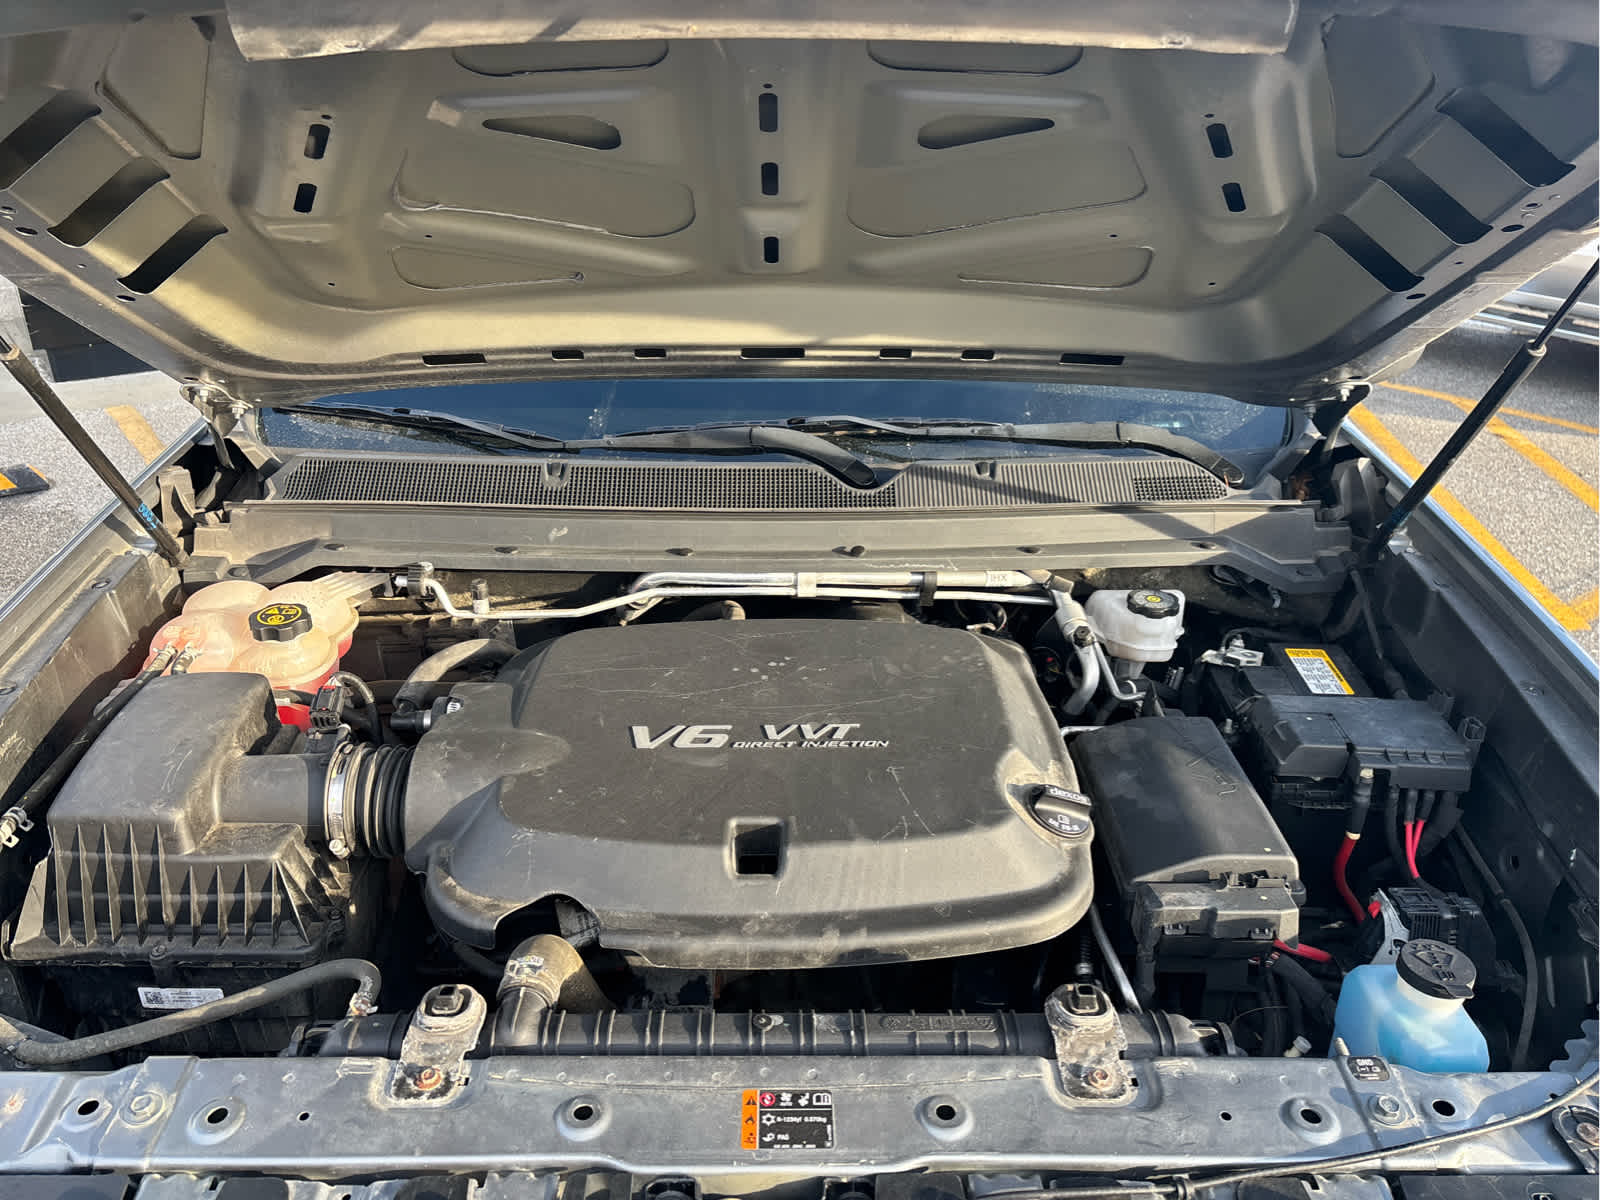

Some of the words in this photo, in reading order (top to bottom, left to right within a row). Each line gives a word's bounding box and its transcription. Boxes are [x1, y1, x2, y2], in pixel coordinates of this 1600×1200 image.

[629, 725, 733, 749] V6
[761, 723, 861, 740] VVT
[731, 740, 796, 749] DIRECT
[802, 740, 889, 749] INJECTION
